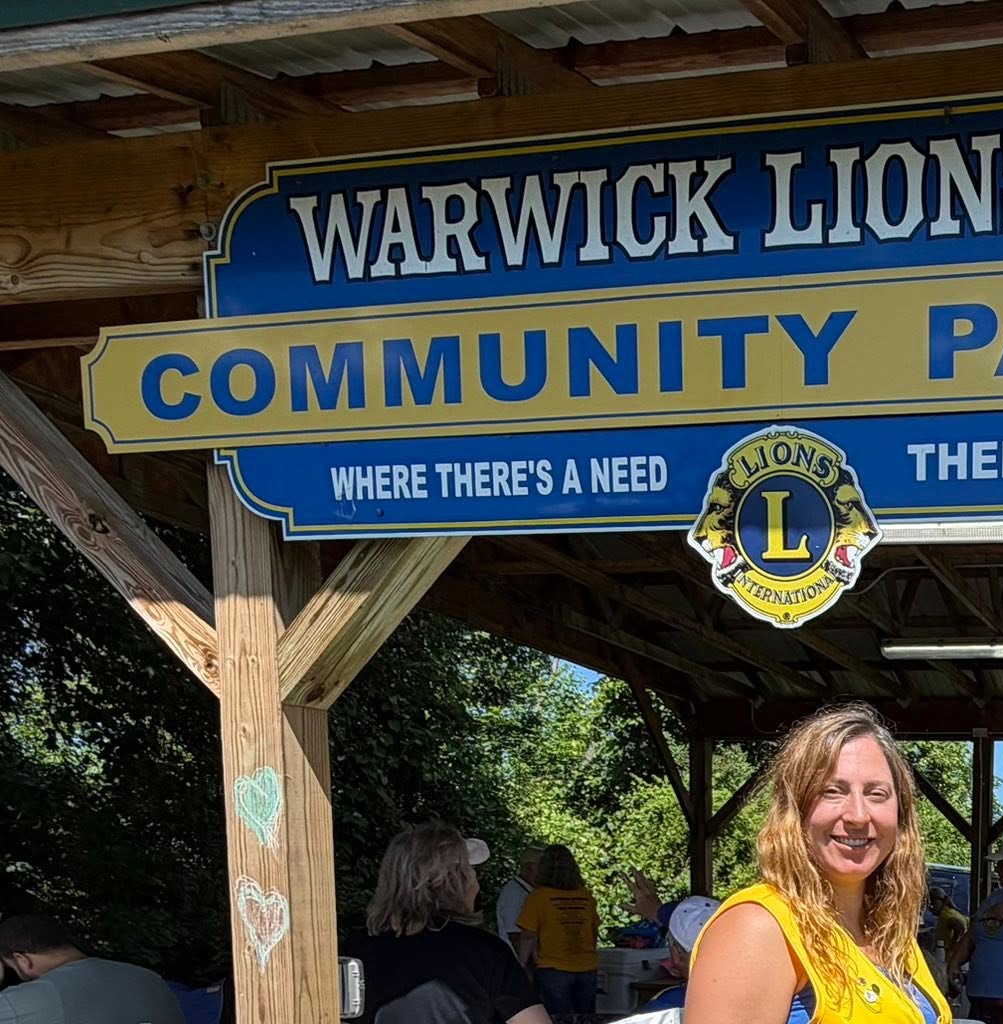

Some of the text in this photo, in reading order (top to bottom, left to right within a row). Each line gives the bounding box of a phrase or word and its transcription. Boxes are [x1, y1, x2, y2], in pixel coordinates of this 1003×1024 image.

[290, 157, 735, 282] WARWICK
[140, 310, 857, 420] COMMUNITY
[330, 455, 668, 501] WHERE THERE'S A NEED
[737, 441, 834, 479] LIONS
[761, 491, 811, 560] L
